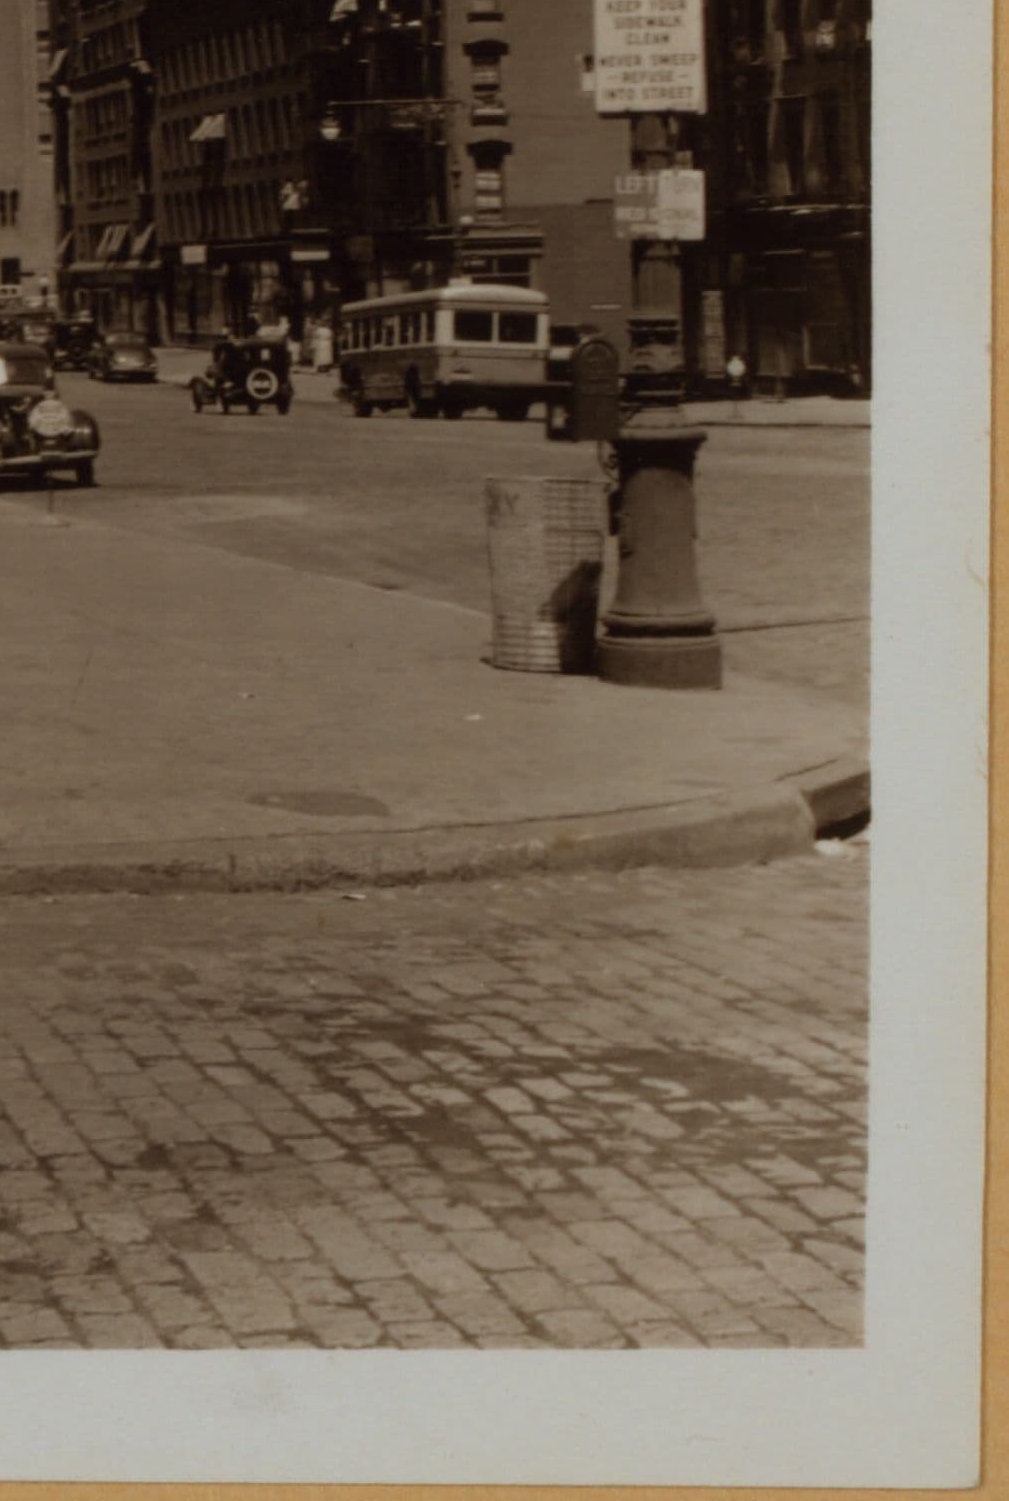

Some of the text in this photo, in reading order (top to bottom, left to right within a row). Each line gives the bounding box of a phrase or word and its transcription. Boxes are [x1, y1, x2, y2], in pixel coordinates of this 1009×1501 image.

[606, 0, 641, 13] KEEP
[613, 16, 682, 30] SIDEWALK
[599, 53, 697, 68] NEVER SWEEP
[641, 86, 695, 100] STREET
